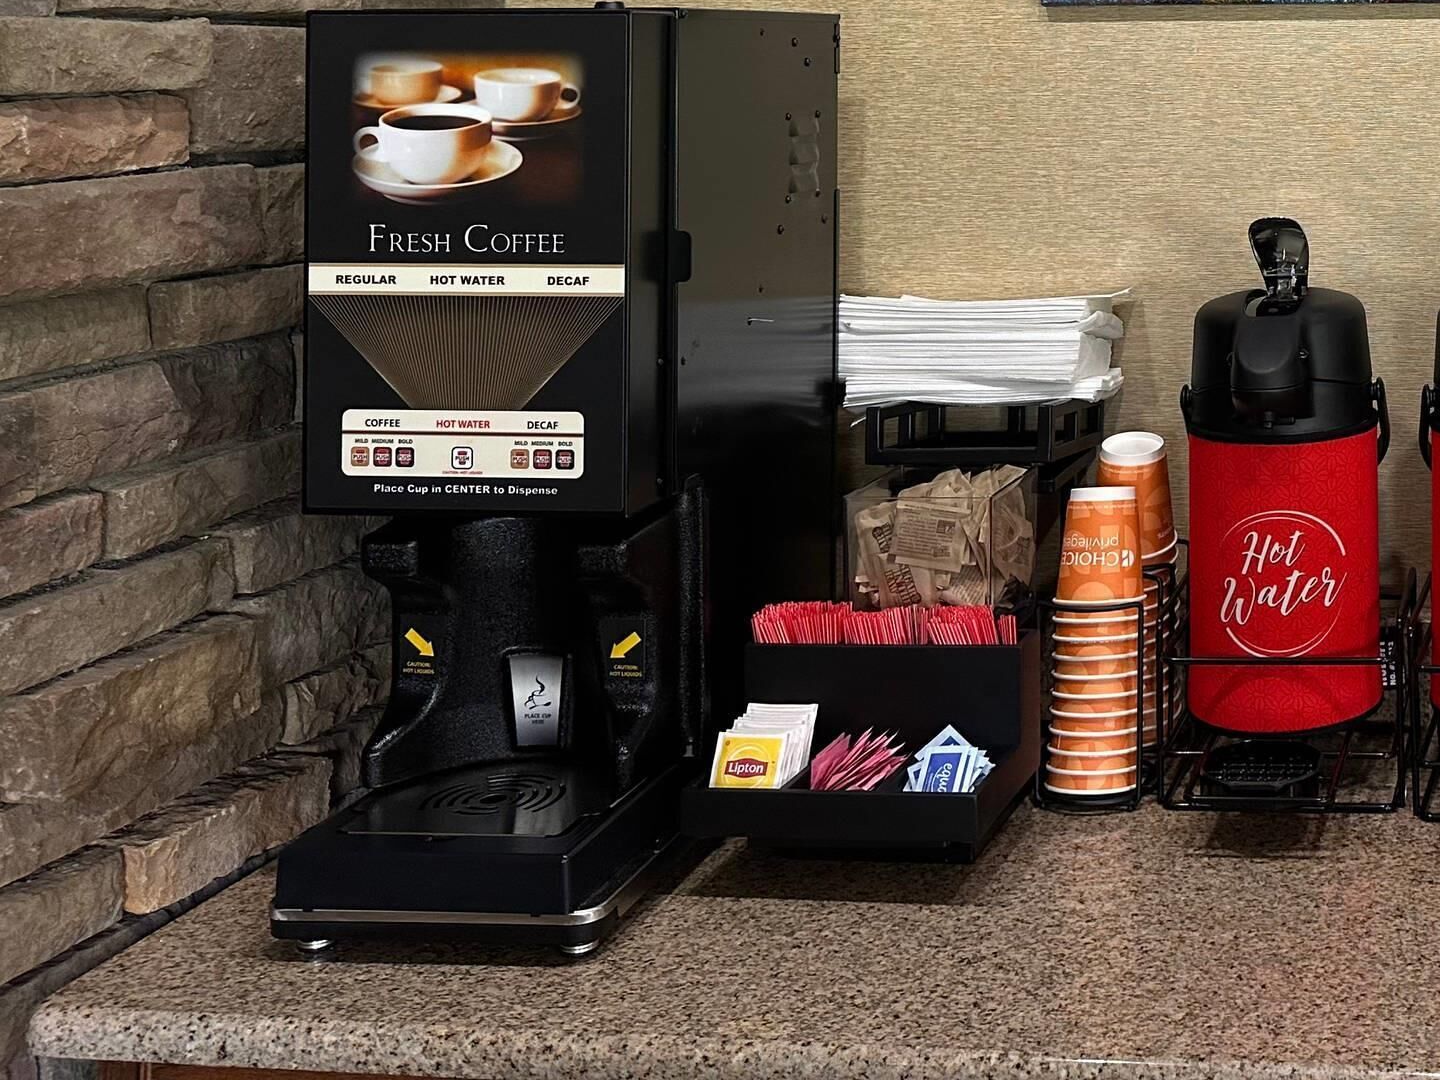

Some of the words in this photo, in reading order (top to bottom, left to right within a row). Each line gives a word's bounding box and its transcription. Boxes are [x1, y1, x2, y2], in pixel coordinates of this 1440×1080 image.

[368, 223, 451, 253] FRESH
[463, 223, 566, 253] COFFEE
[335, 274, 397, 286] REGULAR
[429, 275, 457, 286] HOT
[460, 275, 505, 287] WATER
[547, 276, 590, 287] DECAF
[364, 418, 401, 428] COFFEE
[436, 419, 456, 429] HOT
[457, 420, 491, 429] WATER
[527, 421, 560, 430] DECAF
[373, 483, 405, 494] Place
[407, 484, 429, 495] Cup
[431, 484, 442, 494] in
[445, 484, 491, 494] CENTER
[493, 485, 505, 495] to
[508, 485, 558, 497] Dispense
[1241, 530, 1306, 575] Hot
[1220, 566, 1347, 626] Water
[728, 761, 764, 775] Lipton
